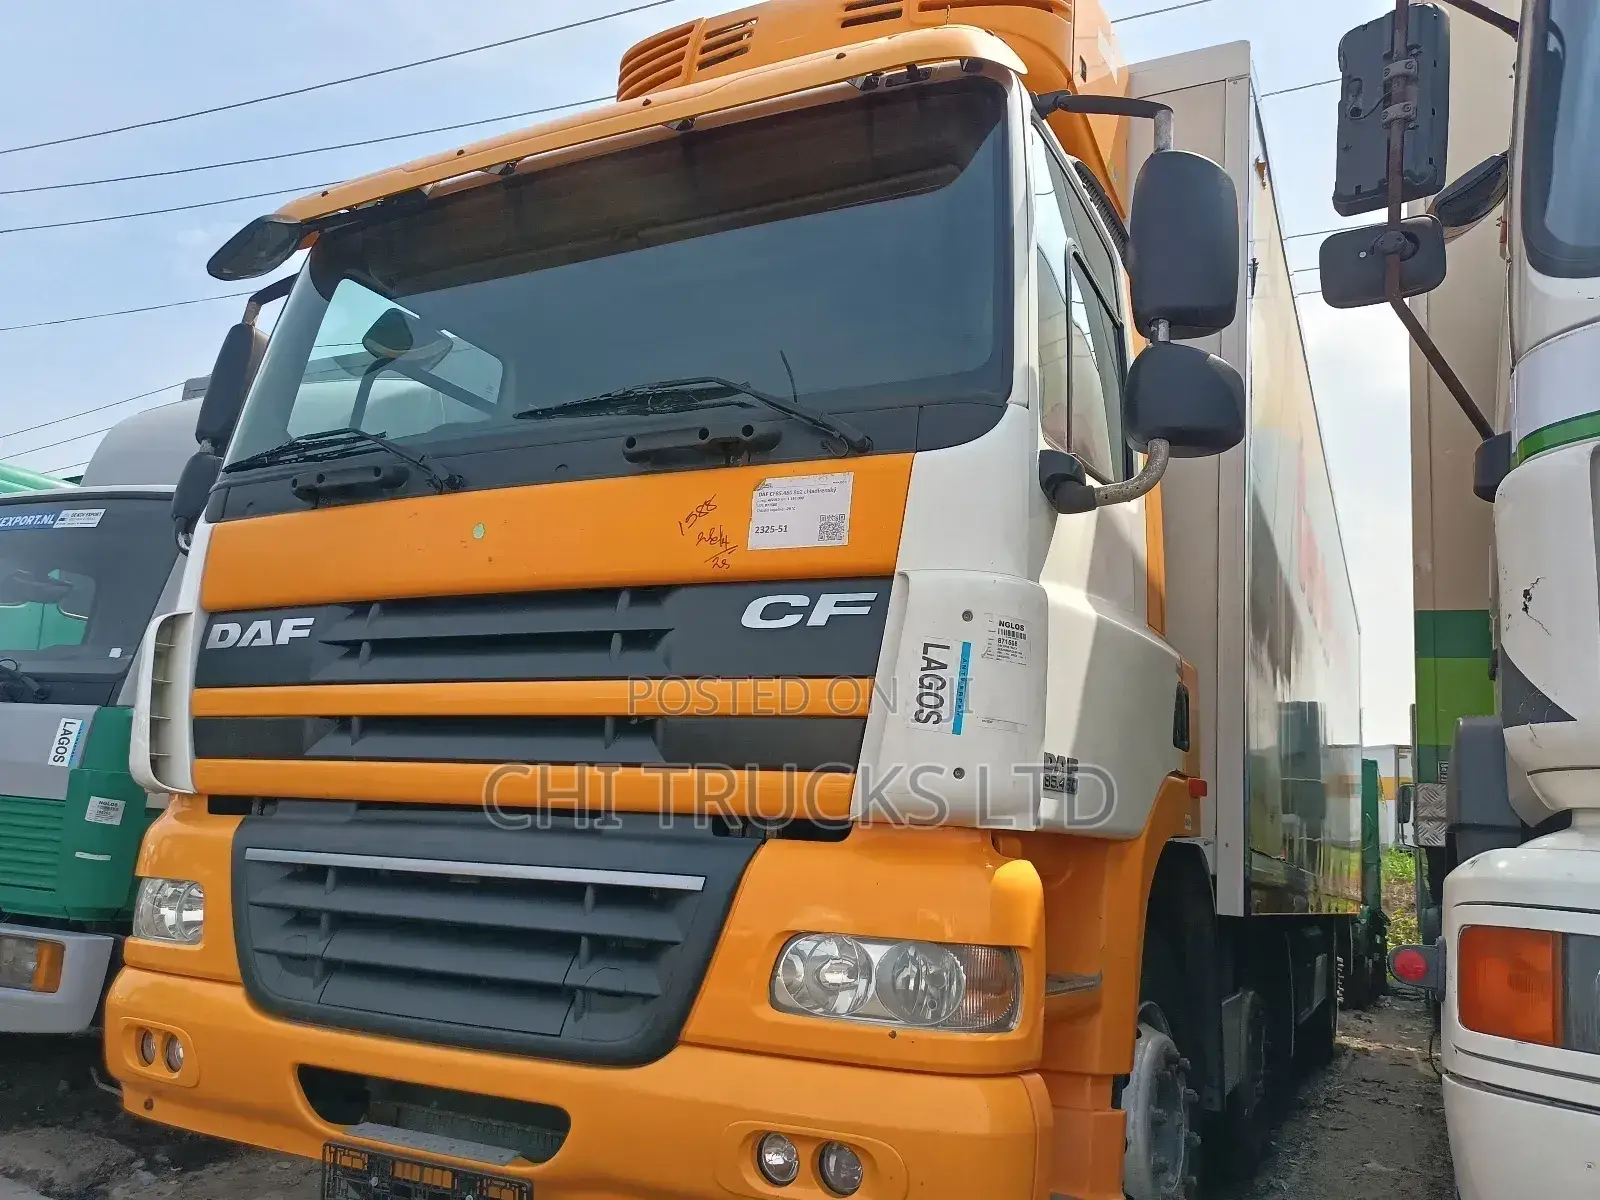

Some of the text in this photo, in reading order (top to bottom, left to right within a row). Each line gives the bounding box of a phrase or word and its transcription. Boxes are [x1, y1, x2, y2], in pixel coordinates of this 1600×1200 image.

[754, 524, 788, 534] 2325-51
[740, 592, 878, 629] CF
[998, 620, 1025, 631] NGLOS
[205, 617, 315, 650] DAF
[914, 642, 951, 725] LAGOS
[52, 721, 77, 763] LAGOS
